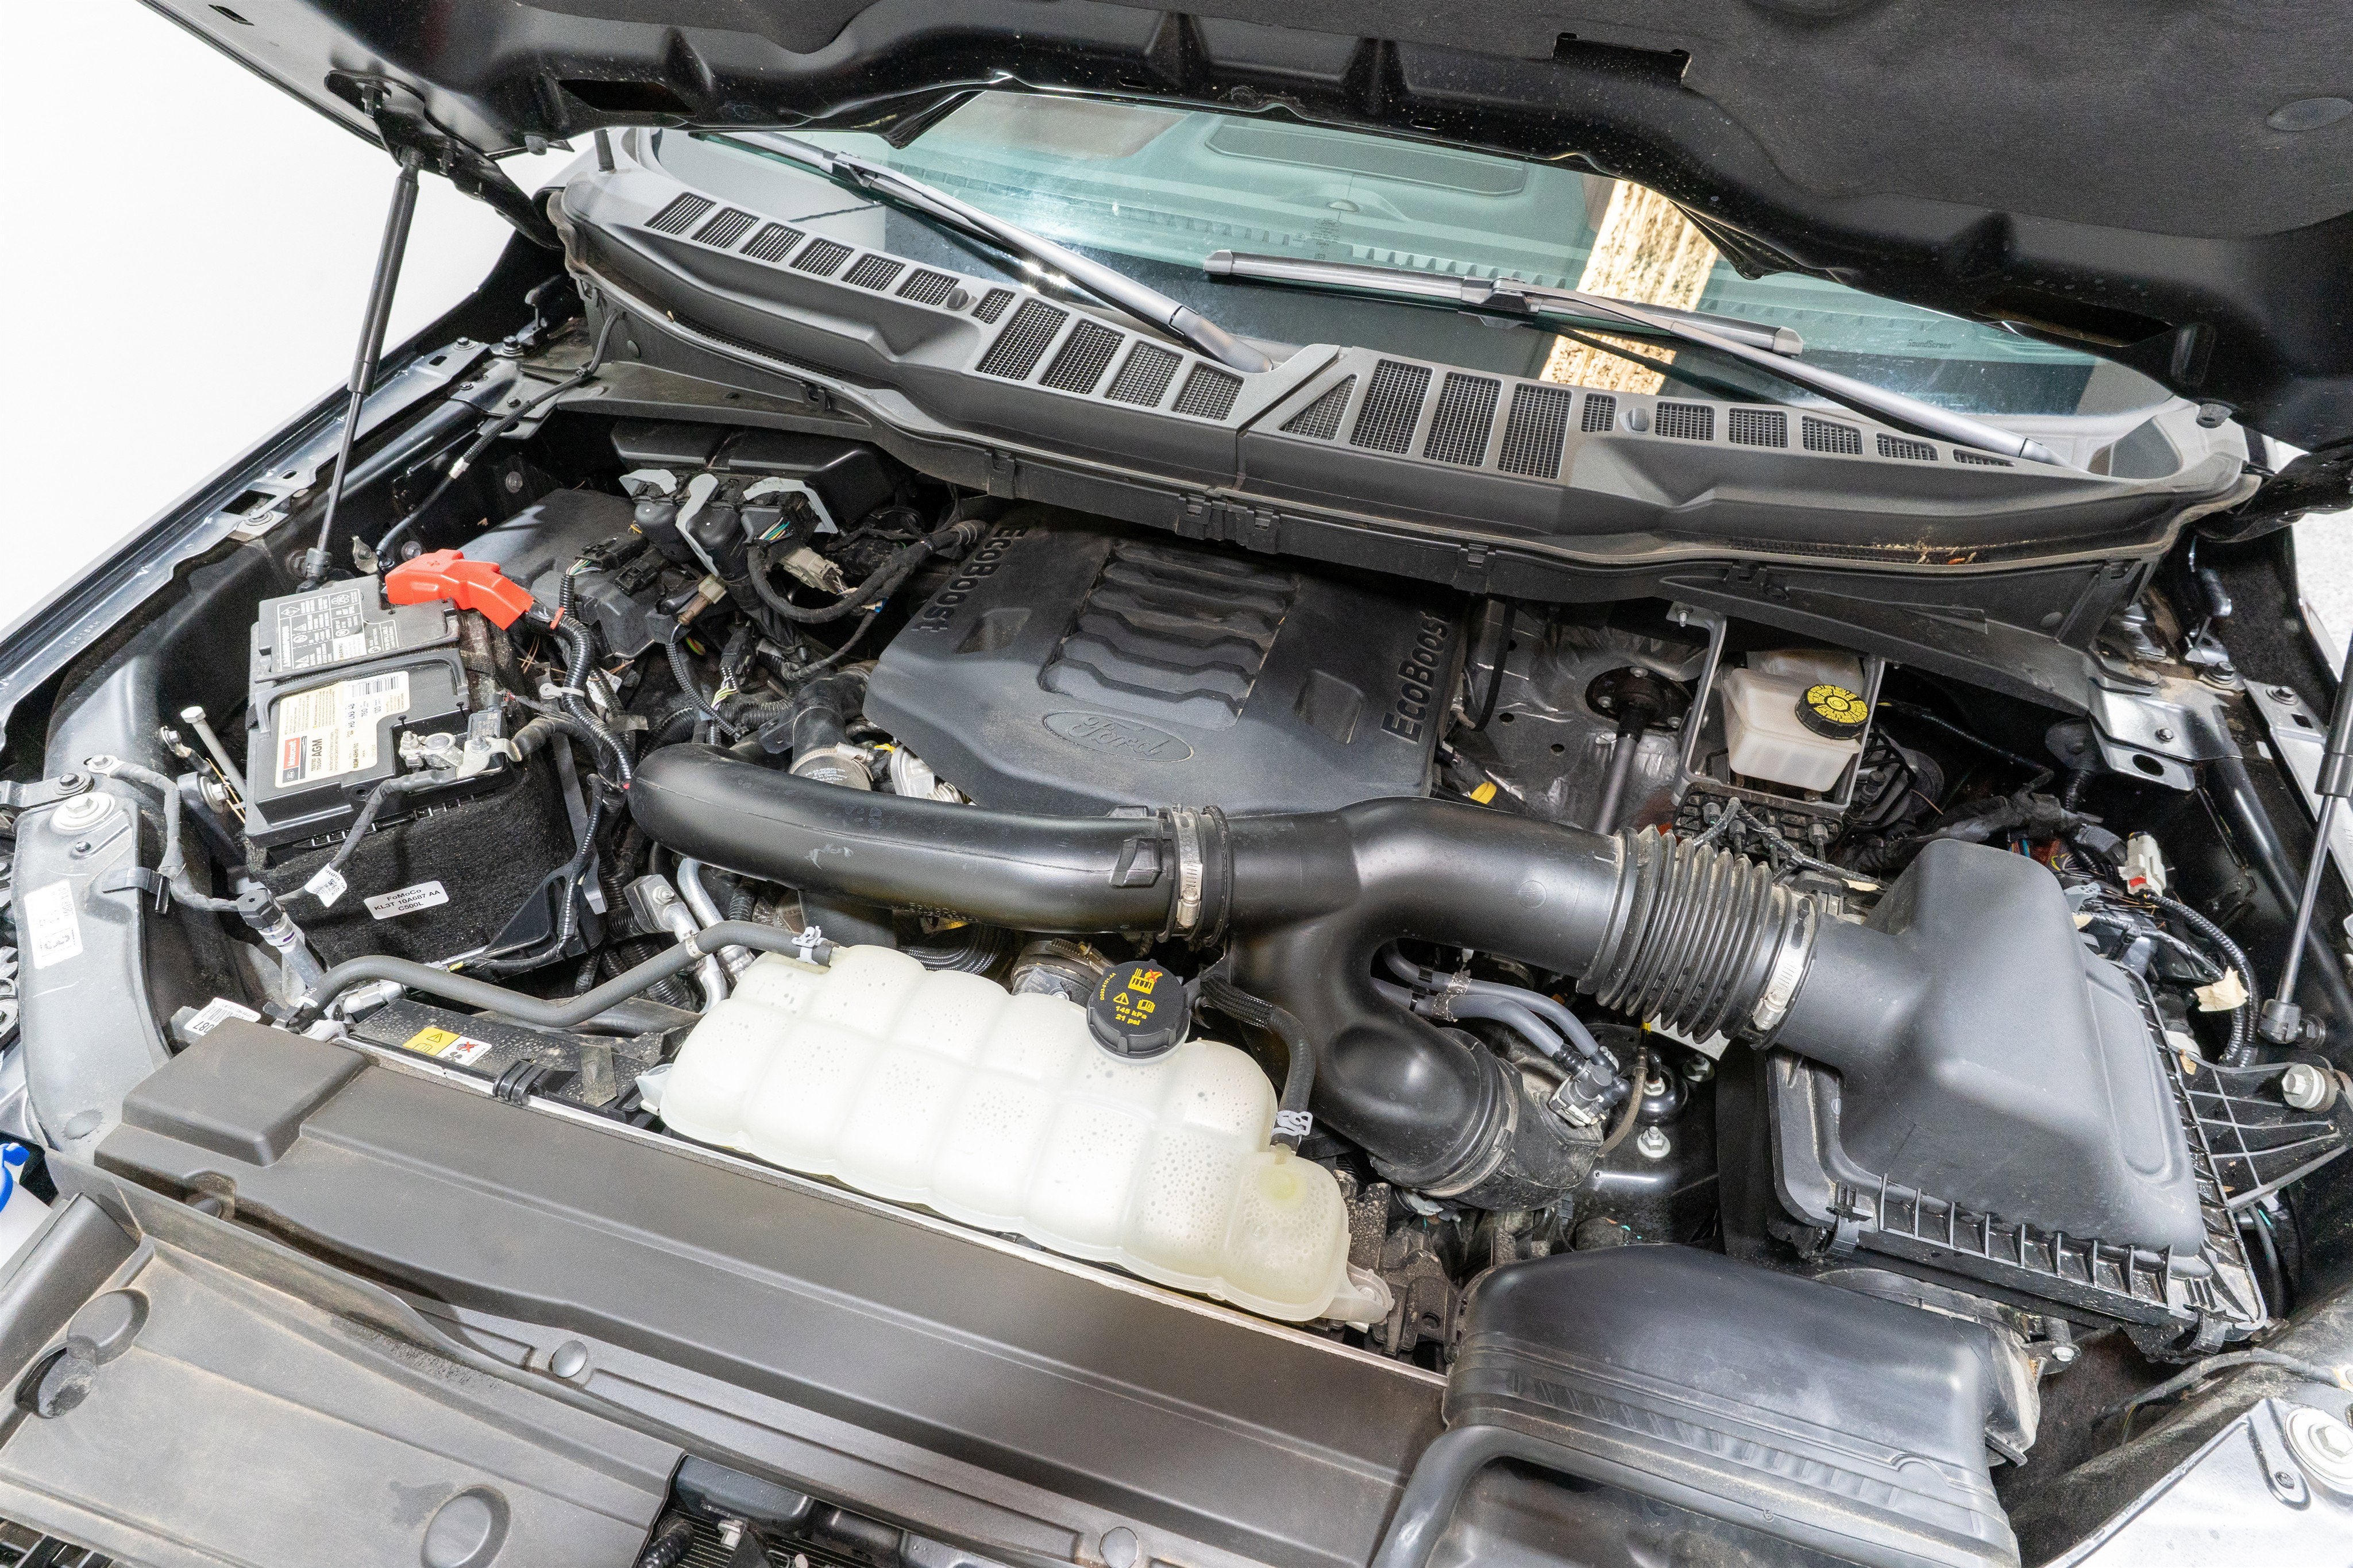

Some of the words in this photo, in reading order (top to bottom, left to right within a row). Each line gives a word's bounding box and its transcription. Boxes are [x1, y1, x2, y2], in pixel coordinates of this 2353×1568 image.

[1067, 715, 1170, 759] Ford
[311, 739, 322, 756] AGM
[387, 889, 422, 901] FoMoCo
[374, 901, 395, 911] KL3T
[398, 893, 426, 905] 10A687
[398, 902, 424, 912] C500L
[304, 987, 318, 997] RAD
[1115, 1005, 1131, 1015] 145
[1131, 1010, 1148, 1020] kPa
[1115, 1014, 1127, 1022] 21
[1127, 1018, 1141, 1026] psi
